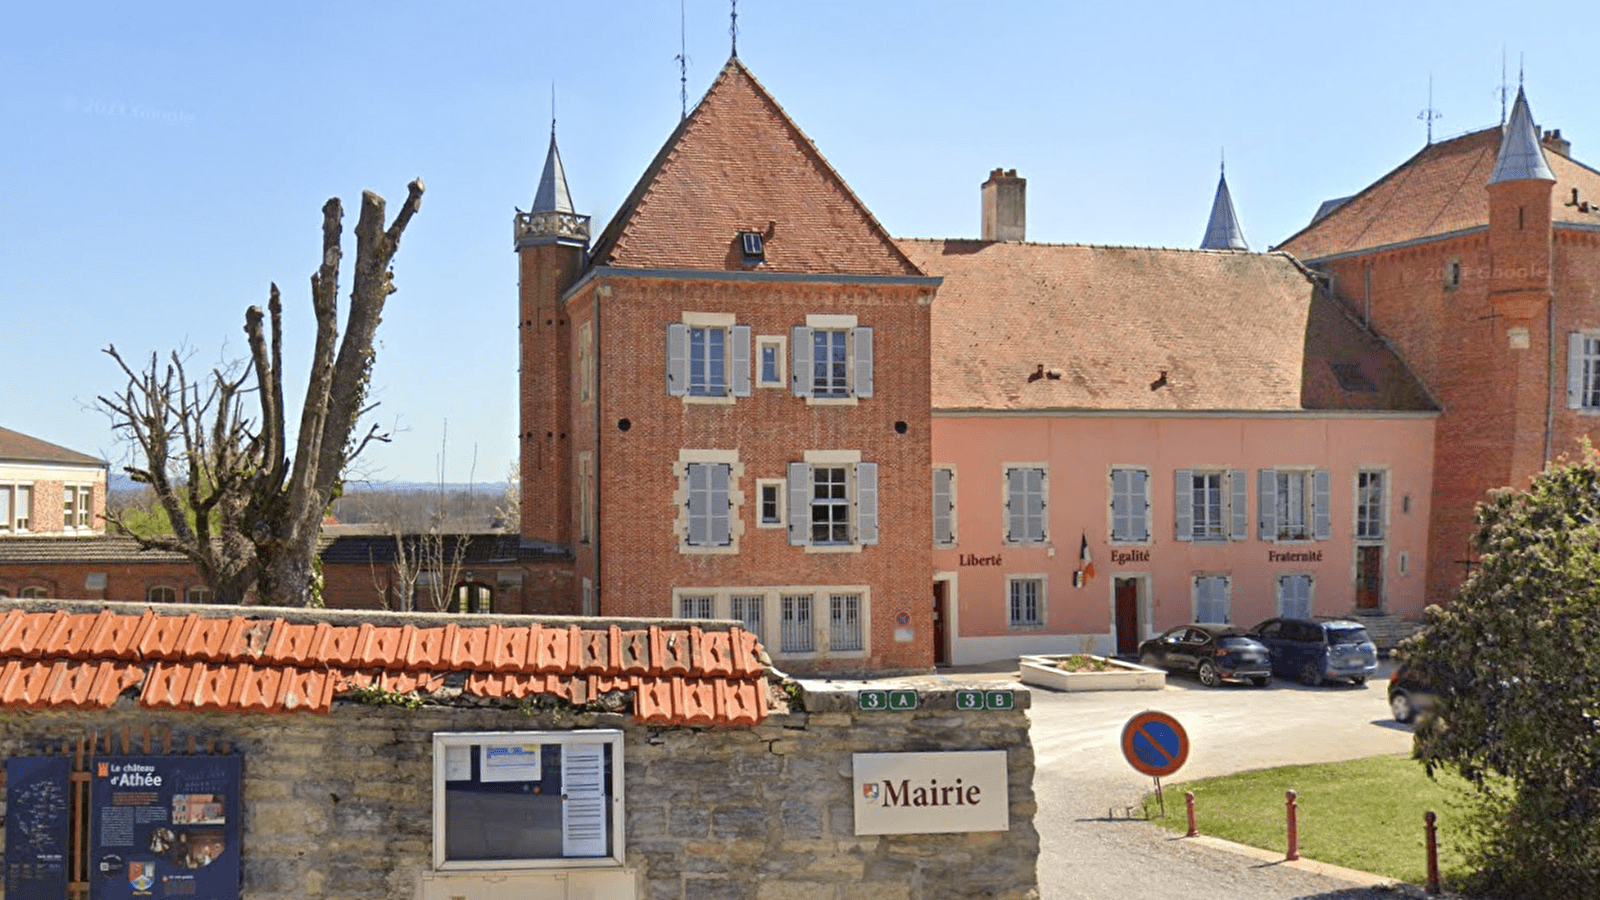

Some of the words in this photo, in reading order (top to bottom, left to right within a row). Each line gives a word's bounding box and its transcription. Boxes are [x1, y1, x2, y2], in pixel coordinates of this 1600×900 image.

[959, 553, 1003, 567] Liberté
[1110, 549, 1150, 565] Egalité
[1268, 549, 1323, 562] Fraternité
[868, 692, 879, 707] 3
[898, 693, 908, 706] A
[965, 692, 976, 707] 3
[995, 693, 1005, 706] B
[110, 764, 121, 772] Le
[123, 763, 155, 772] château
[110, 772, 163, 787] d'Athée
[881, 778, 981, 808] Mairie
